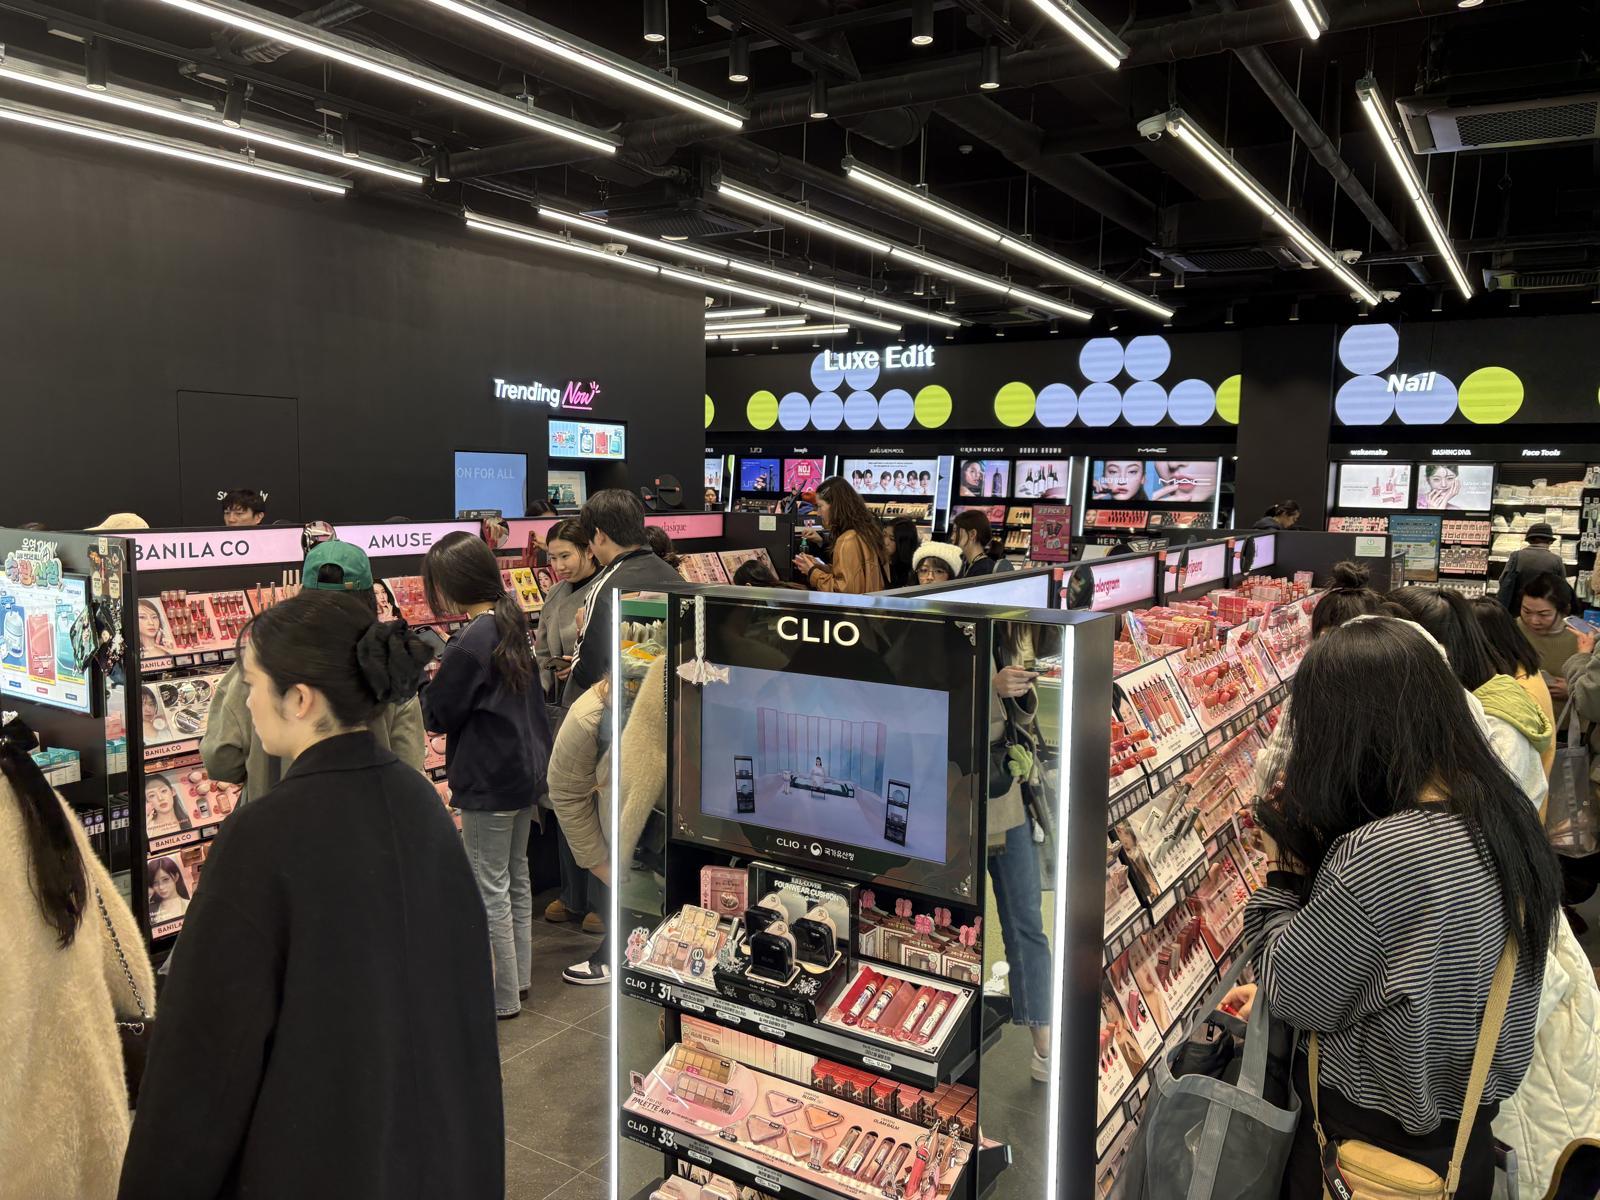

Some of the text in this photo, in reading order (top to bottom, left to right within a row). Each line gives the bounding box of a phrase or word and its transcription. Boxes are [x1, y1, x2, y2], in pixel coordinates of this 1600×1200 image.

[823, 344, 936, 371] Luxe Edit
[1387, 371, 1437, 392] Nail
[494, 378, 595, 408] Trending Now
[474, 467, 495, 479] FOR
[497, 468, 515, 479] ALL
[368, 532, 432, 549] AMUSE
[135, 540, 250, 561] BANILA CO
[776, 616, 860, 646] CLIO
[145, 746, 170, 757] BANILA
[155, 838, 181, 848] BANILA
[776, 838, 800, 849] CLIO
[824, 847, 855, 861] 국가유산청
[810, 888, 838, 901] CUSHION
[157, 922, 183, 934] BANILA
[625, 977, 647, 989] CLIO
[632, 1097, 671, 1116] PALETTE AIR
[627, 1120, 649, 1133] CLIO
[1334, 1178, 1350, 1200] EOS
